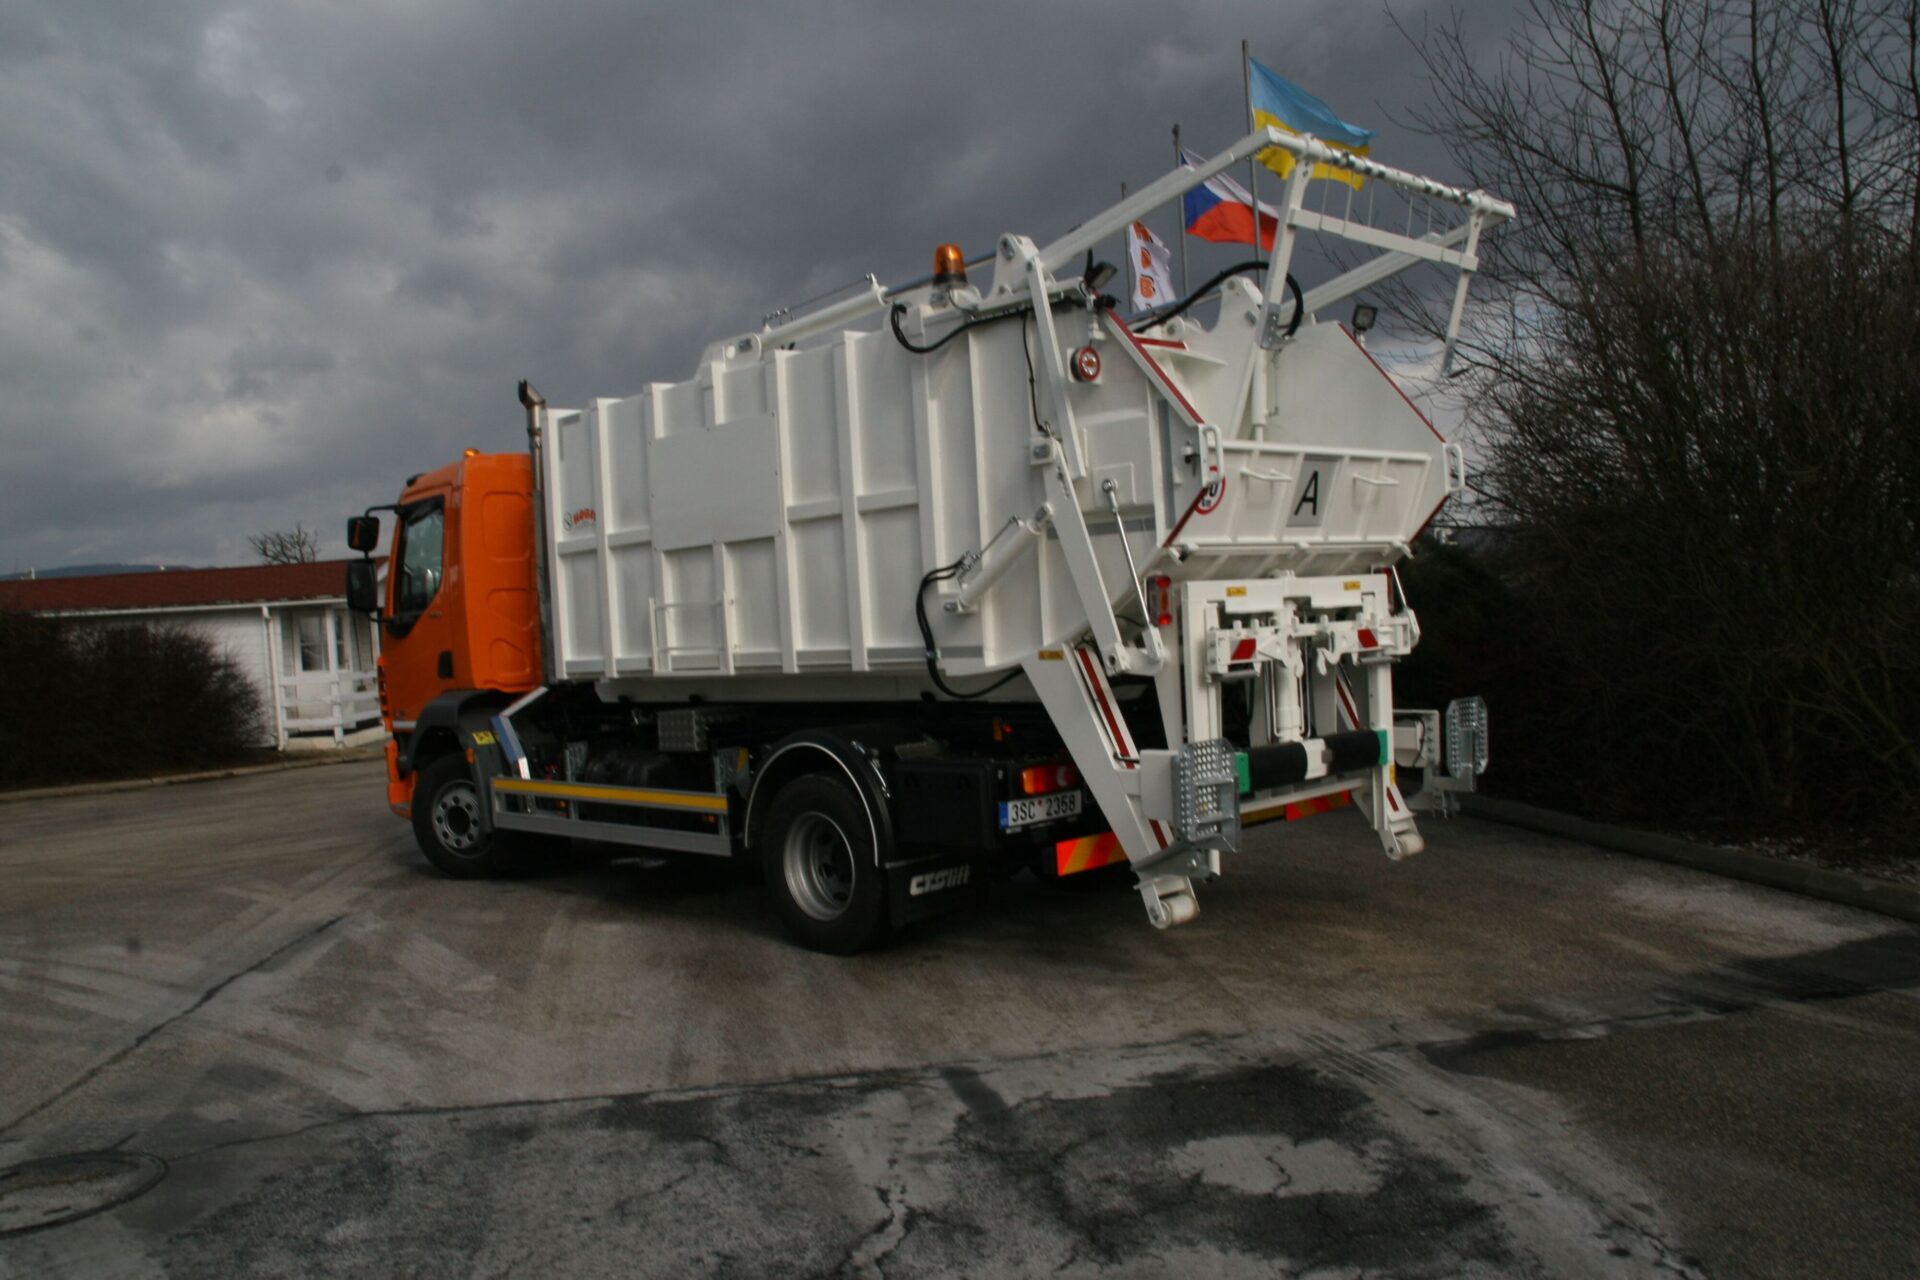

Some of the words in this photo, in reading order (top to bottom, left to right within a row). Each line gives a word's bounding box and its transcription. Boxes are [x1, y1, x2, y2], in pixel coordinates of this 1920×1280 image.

[1294, 470, 1318, 516] A
[1011, 800, 1036, 823] 3SC
[1046, 794, 1075, 817] 2358
